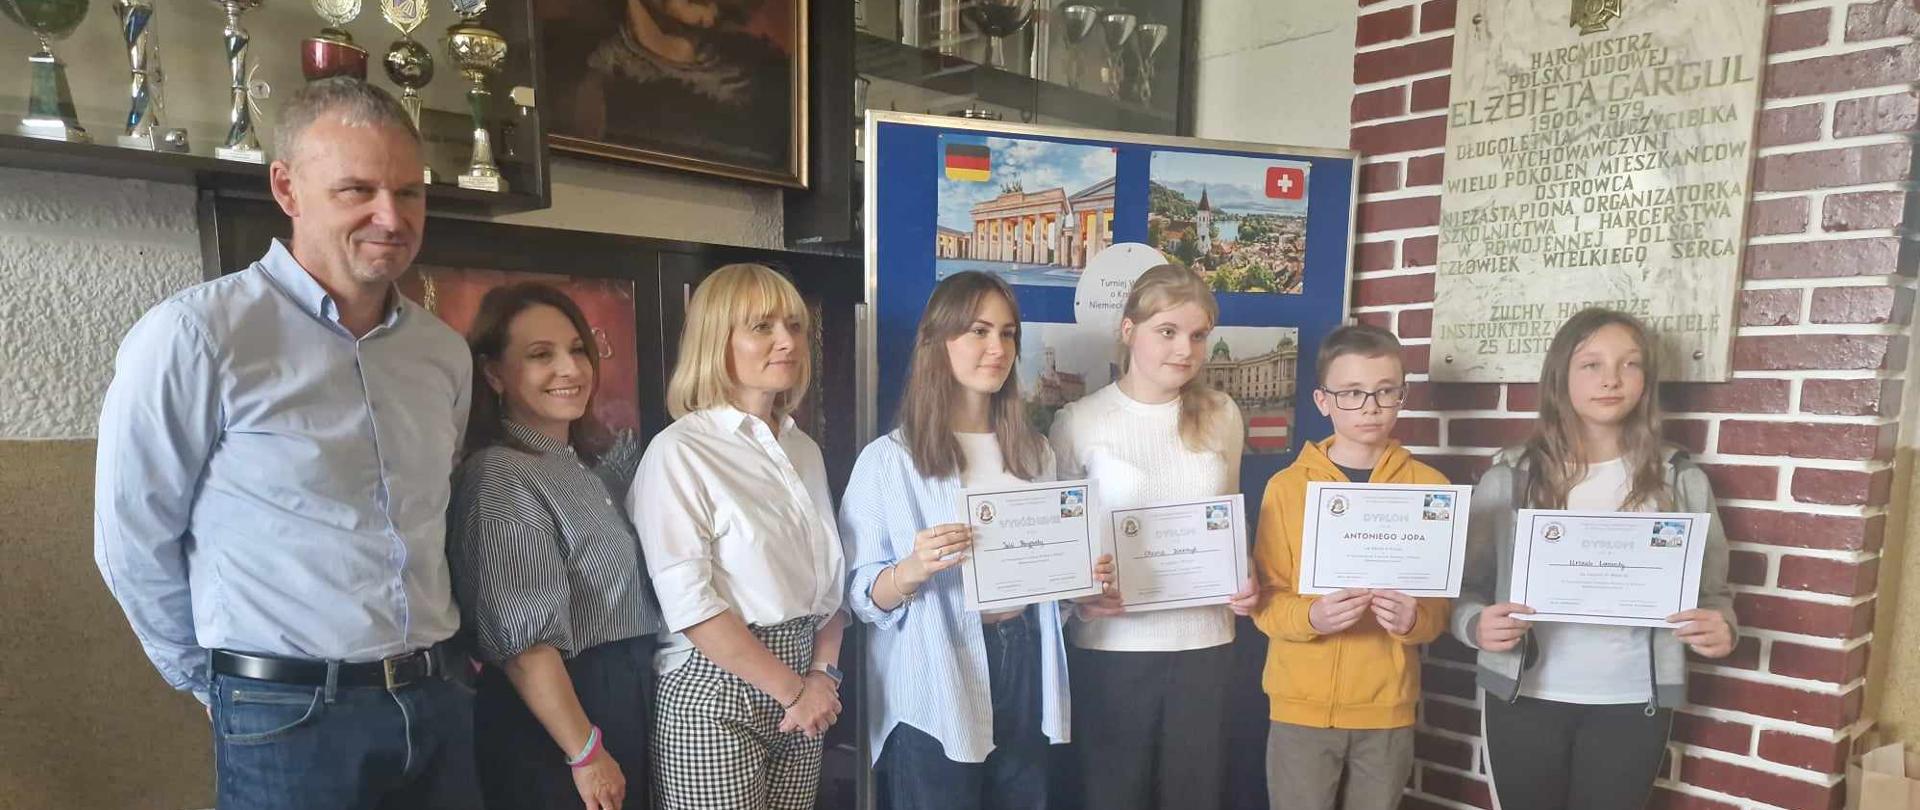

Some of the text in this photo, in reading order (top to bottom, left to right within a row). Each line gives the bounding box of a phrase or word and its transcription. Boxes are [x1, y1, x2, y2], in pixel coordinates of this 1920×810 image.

[1531, 32, 1653, 70] HARCMISTRZ
[1508, 47, 1668, 91] POLSKI LUDOWEJ
[1608, 54, 1754, 102] GARGUL
[1530, 110, 1578, 133] 1900
[1600, 101, 1645, 122] 1979
[1500, 131, 1668, 170] WYCHOWAWCZYNI
[1447, 173, 1497, 194] WIELU
[1535, 174, 1634, 201] OSTROWCA
[1584, 180, 1742, 213] ORGANIZATORKA
[1440, 202, 1732, 245] SZKOLNICTWA I HARCERSTWA
[1458, 222, 1706, 258] W POWOJENNEJ POLSCE
[1543, 245, 1648, 268] WIELKIEGO
[1671, 238, 1736, 260] SERCA
[1490, 303, 1545, 322] ZUCHY
[1478, 339, 1499, 355] 25
[1344, 532, 1397, 541] ANTONIEGO
